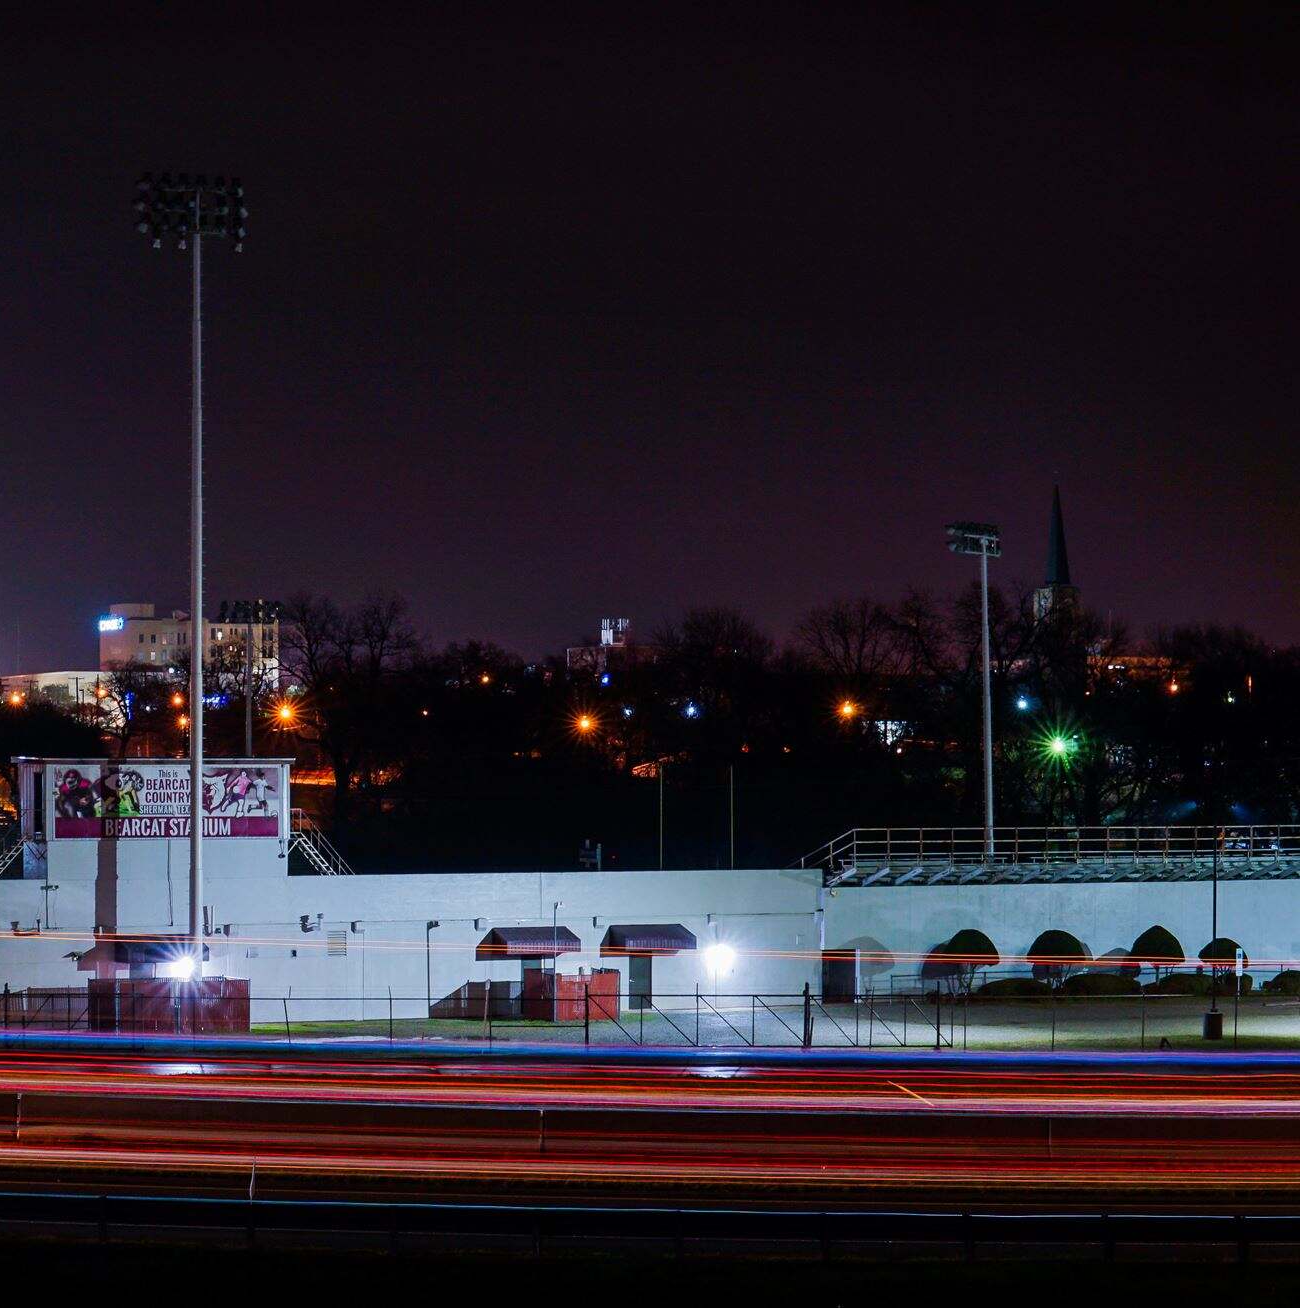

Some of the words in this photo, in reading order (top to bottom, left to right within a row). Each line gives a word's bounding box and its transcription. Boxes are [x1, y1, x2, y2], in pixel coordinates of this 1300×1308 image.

[158, 769, 171, 778] This
[172, 769, 178, 778] is
[146, 778, 190, 791] BEARCAT
[145, 791, 191, 804] COUNTRY
[105, 818, 167, 836] BEARCAT
[169, 818, 231, 836] STAIUM
